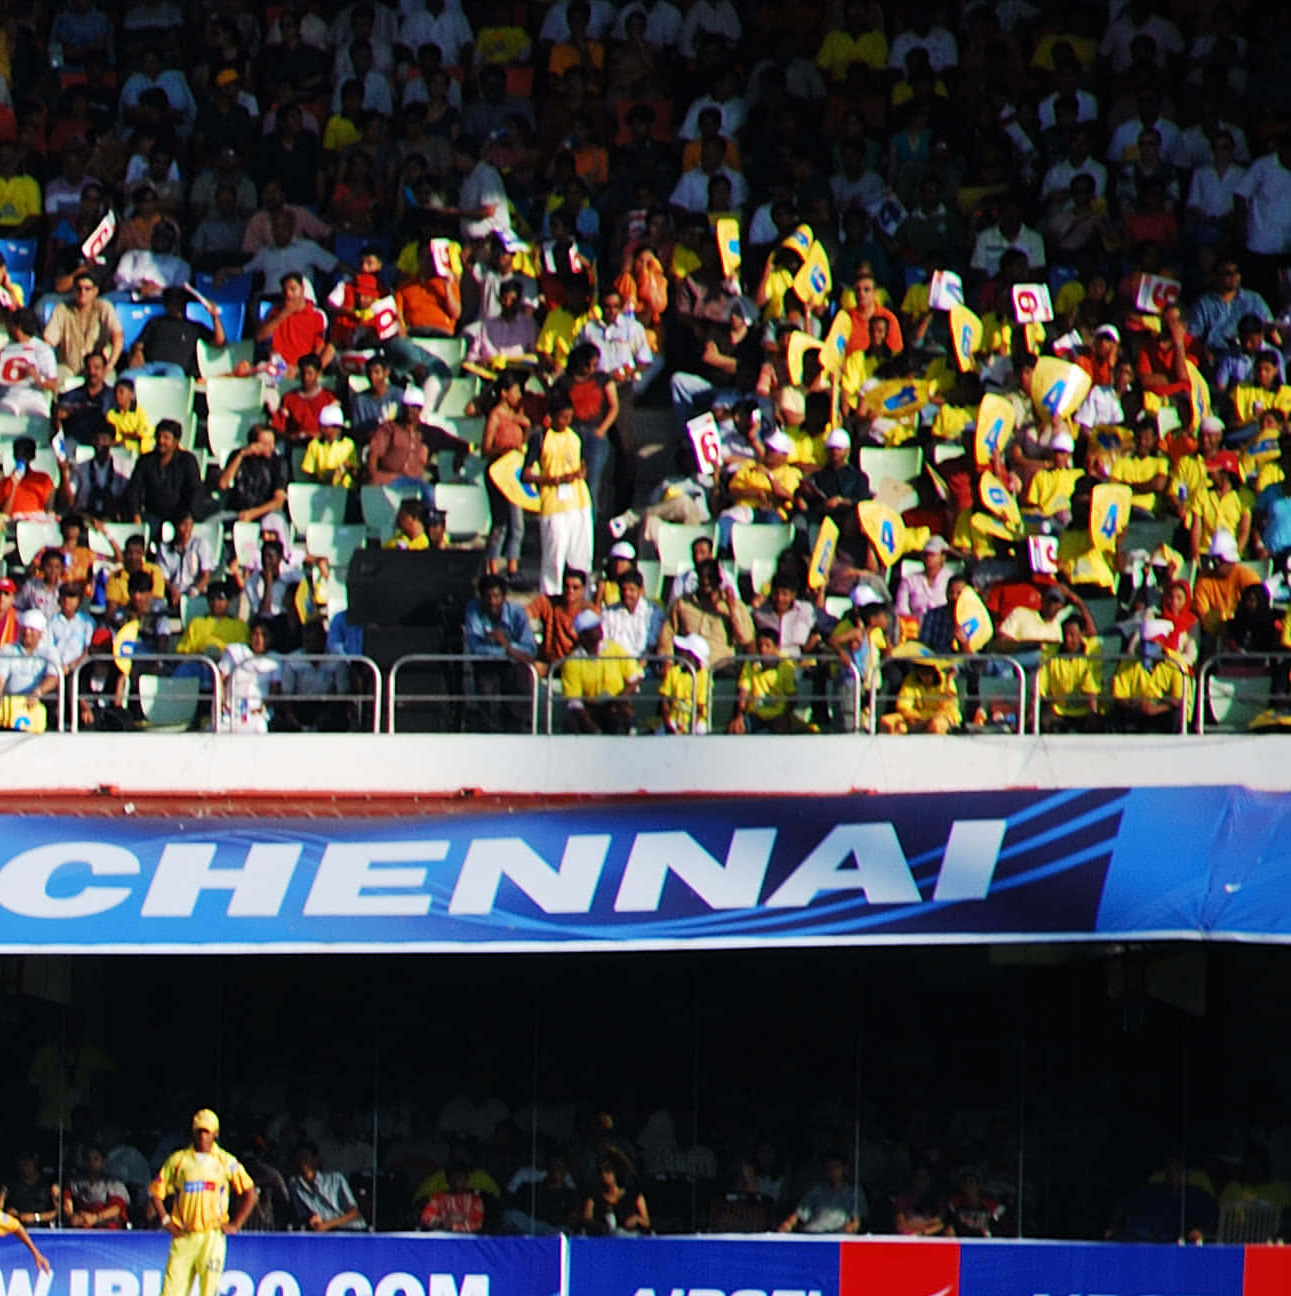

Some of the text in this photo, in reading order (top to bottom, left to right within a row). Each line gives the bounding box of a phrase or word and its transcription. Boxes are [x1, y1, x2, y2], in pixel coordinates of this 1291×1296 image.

[700, 431, 720, 463] 6
[882, 520, 895, 554] 4
[1101, 503, 1118, 540] 4
